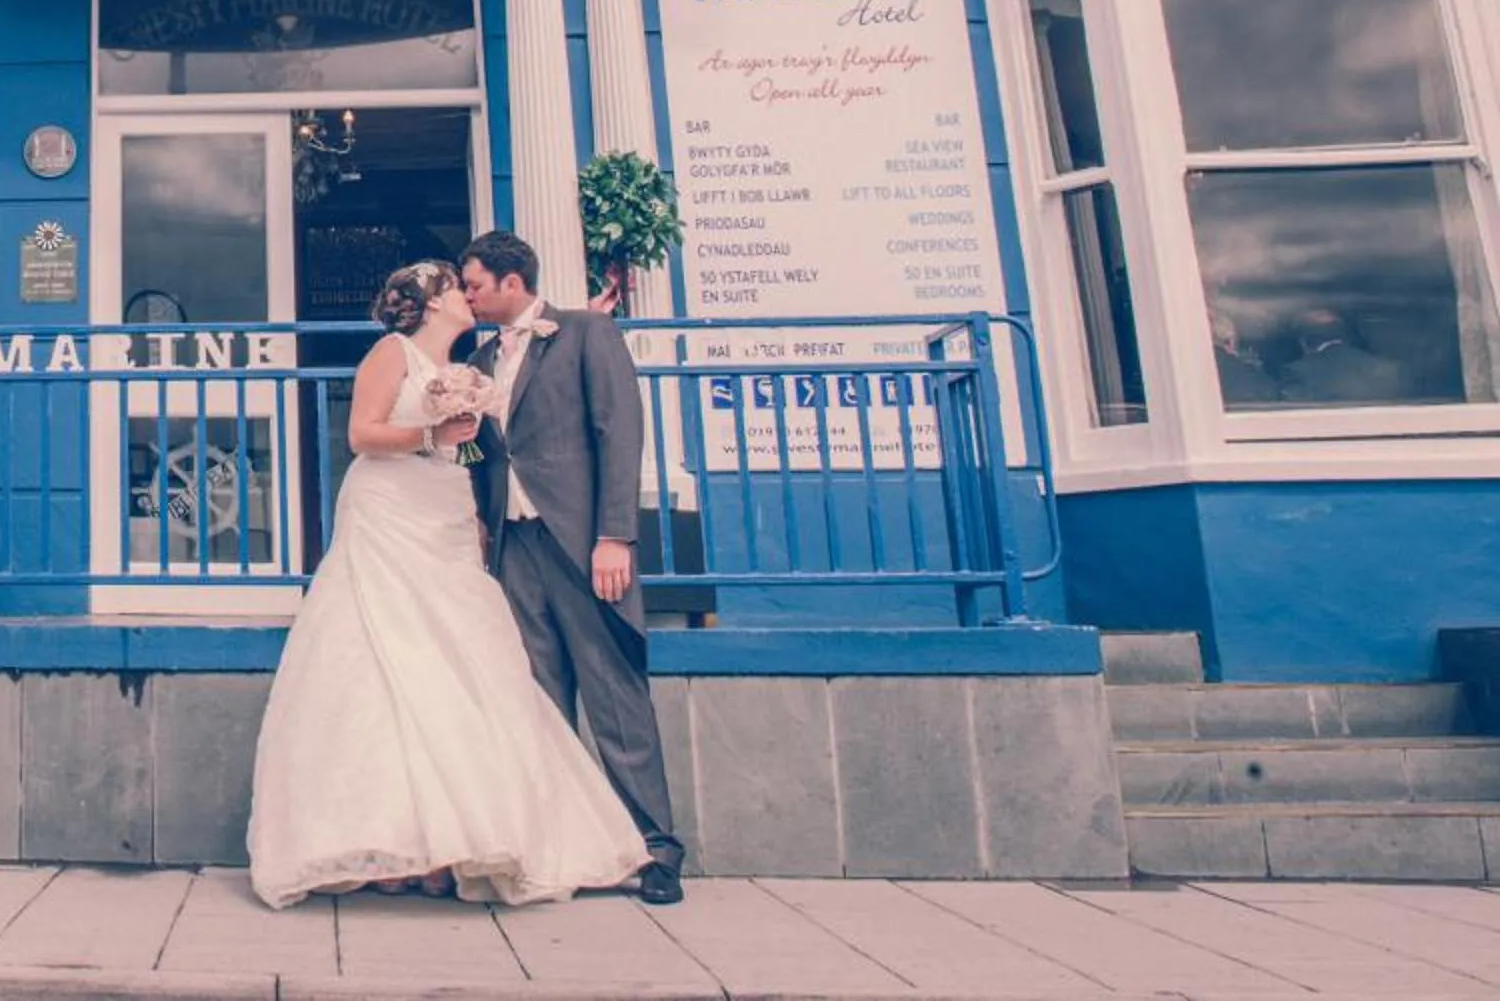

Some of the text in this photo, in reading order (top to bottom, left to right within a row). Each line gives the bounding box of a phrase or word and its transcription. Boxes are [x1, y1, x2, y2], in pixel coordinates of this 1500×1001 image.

[750, 75, 887, 106] Open all year
[686, 120, 711, 134] BAR
[934, 113, 961, 128] BAR
[688, 145, 770, 159] BWYTY GYDA
[905, 140, 964, 155] SEA VIEW
[885, 158, 966, 173] RESTAURANT
[842, 184, 972, 201] LIFT TO ALL FLOORS
[908, 210, 976, 226] WEDDINGS
[886, 238, 980, 254] CONFERENCES
[700, 268, 820, 285] 50 YSTAFELL WELY
[904, 264, 982, 281] 50 EN SUITE
[702, 288, 760, 304] EN SUITE
[915, 284, 987, 300] BEDROOMS
